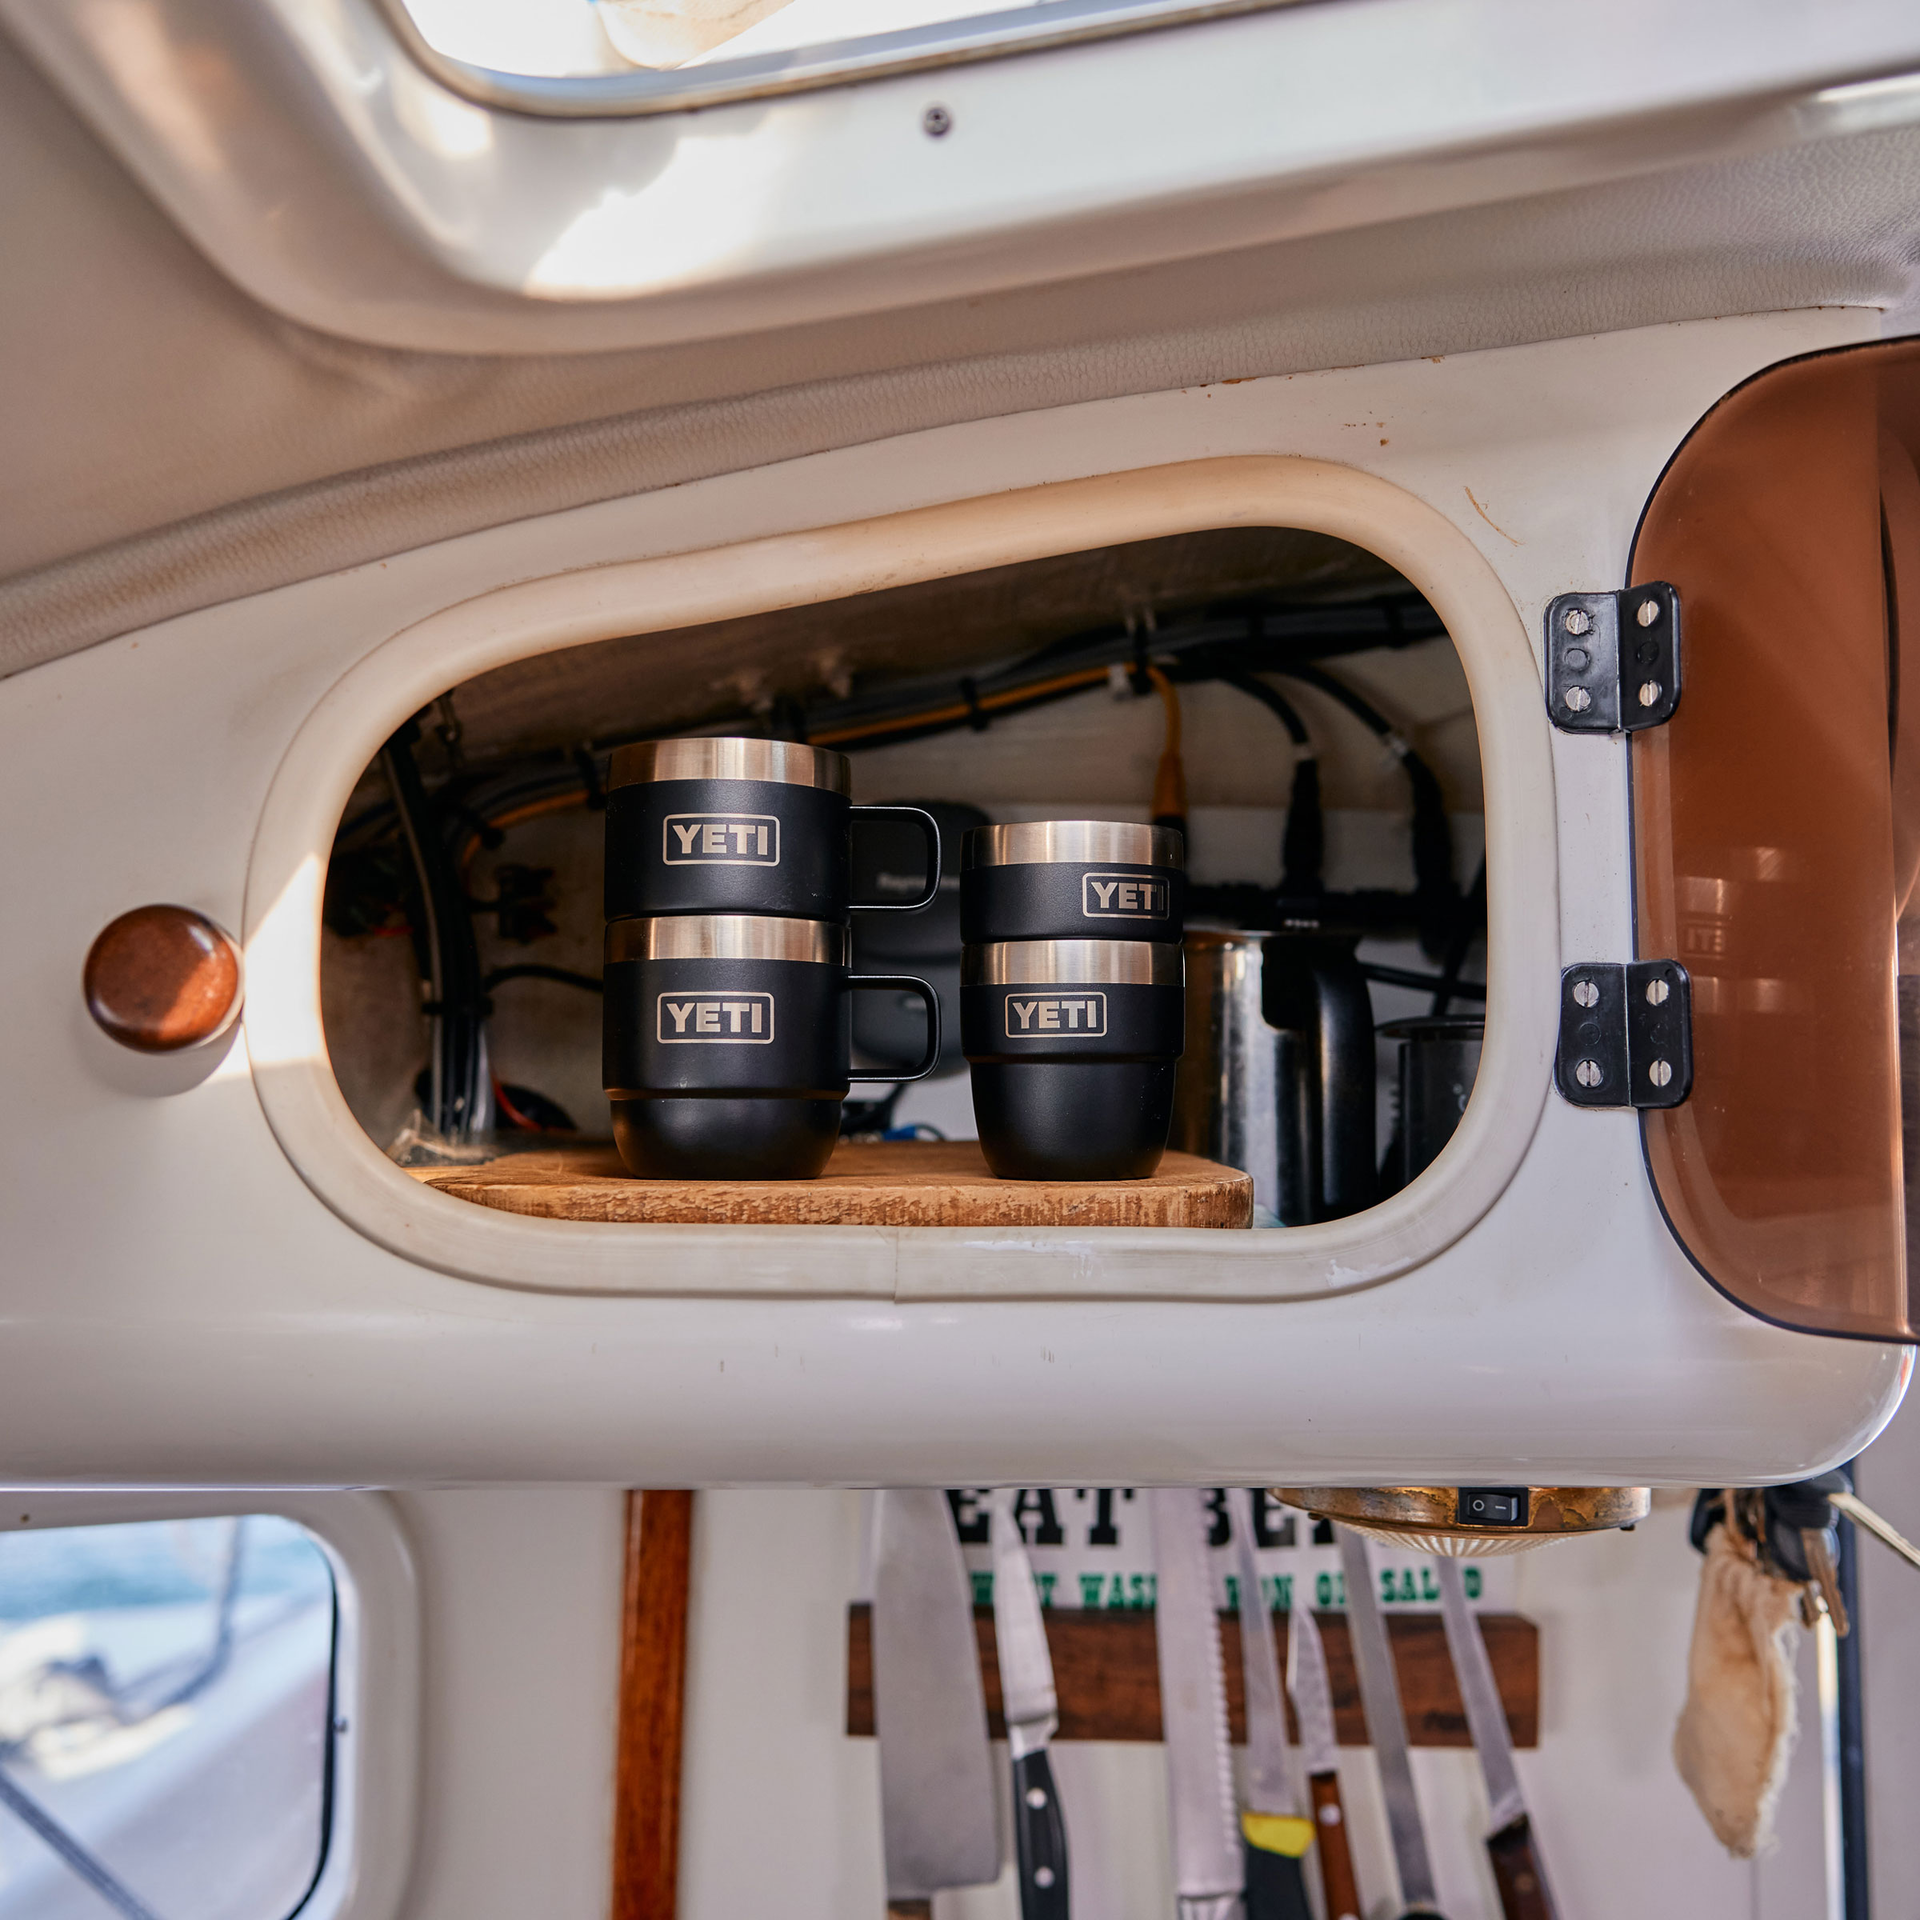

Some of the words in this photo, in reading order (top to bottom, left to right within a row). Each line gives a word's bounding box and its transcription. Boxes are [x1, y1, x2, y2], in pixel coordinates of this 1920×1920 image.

[672, 823, 768, 856] YETI
[1090, 881, 1165, 912] YETI
[666, 1002, 762, 1034] YETI
[1011, 1000, 1097, 1029] YETI
[1380, 1566, 1483, 1602] SALD
